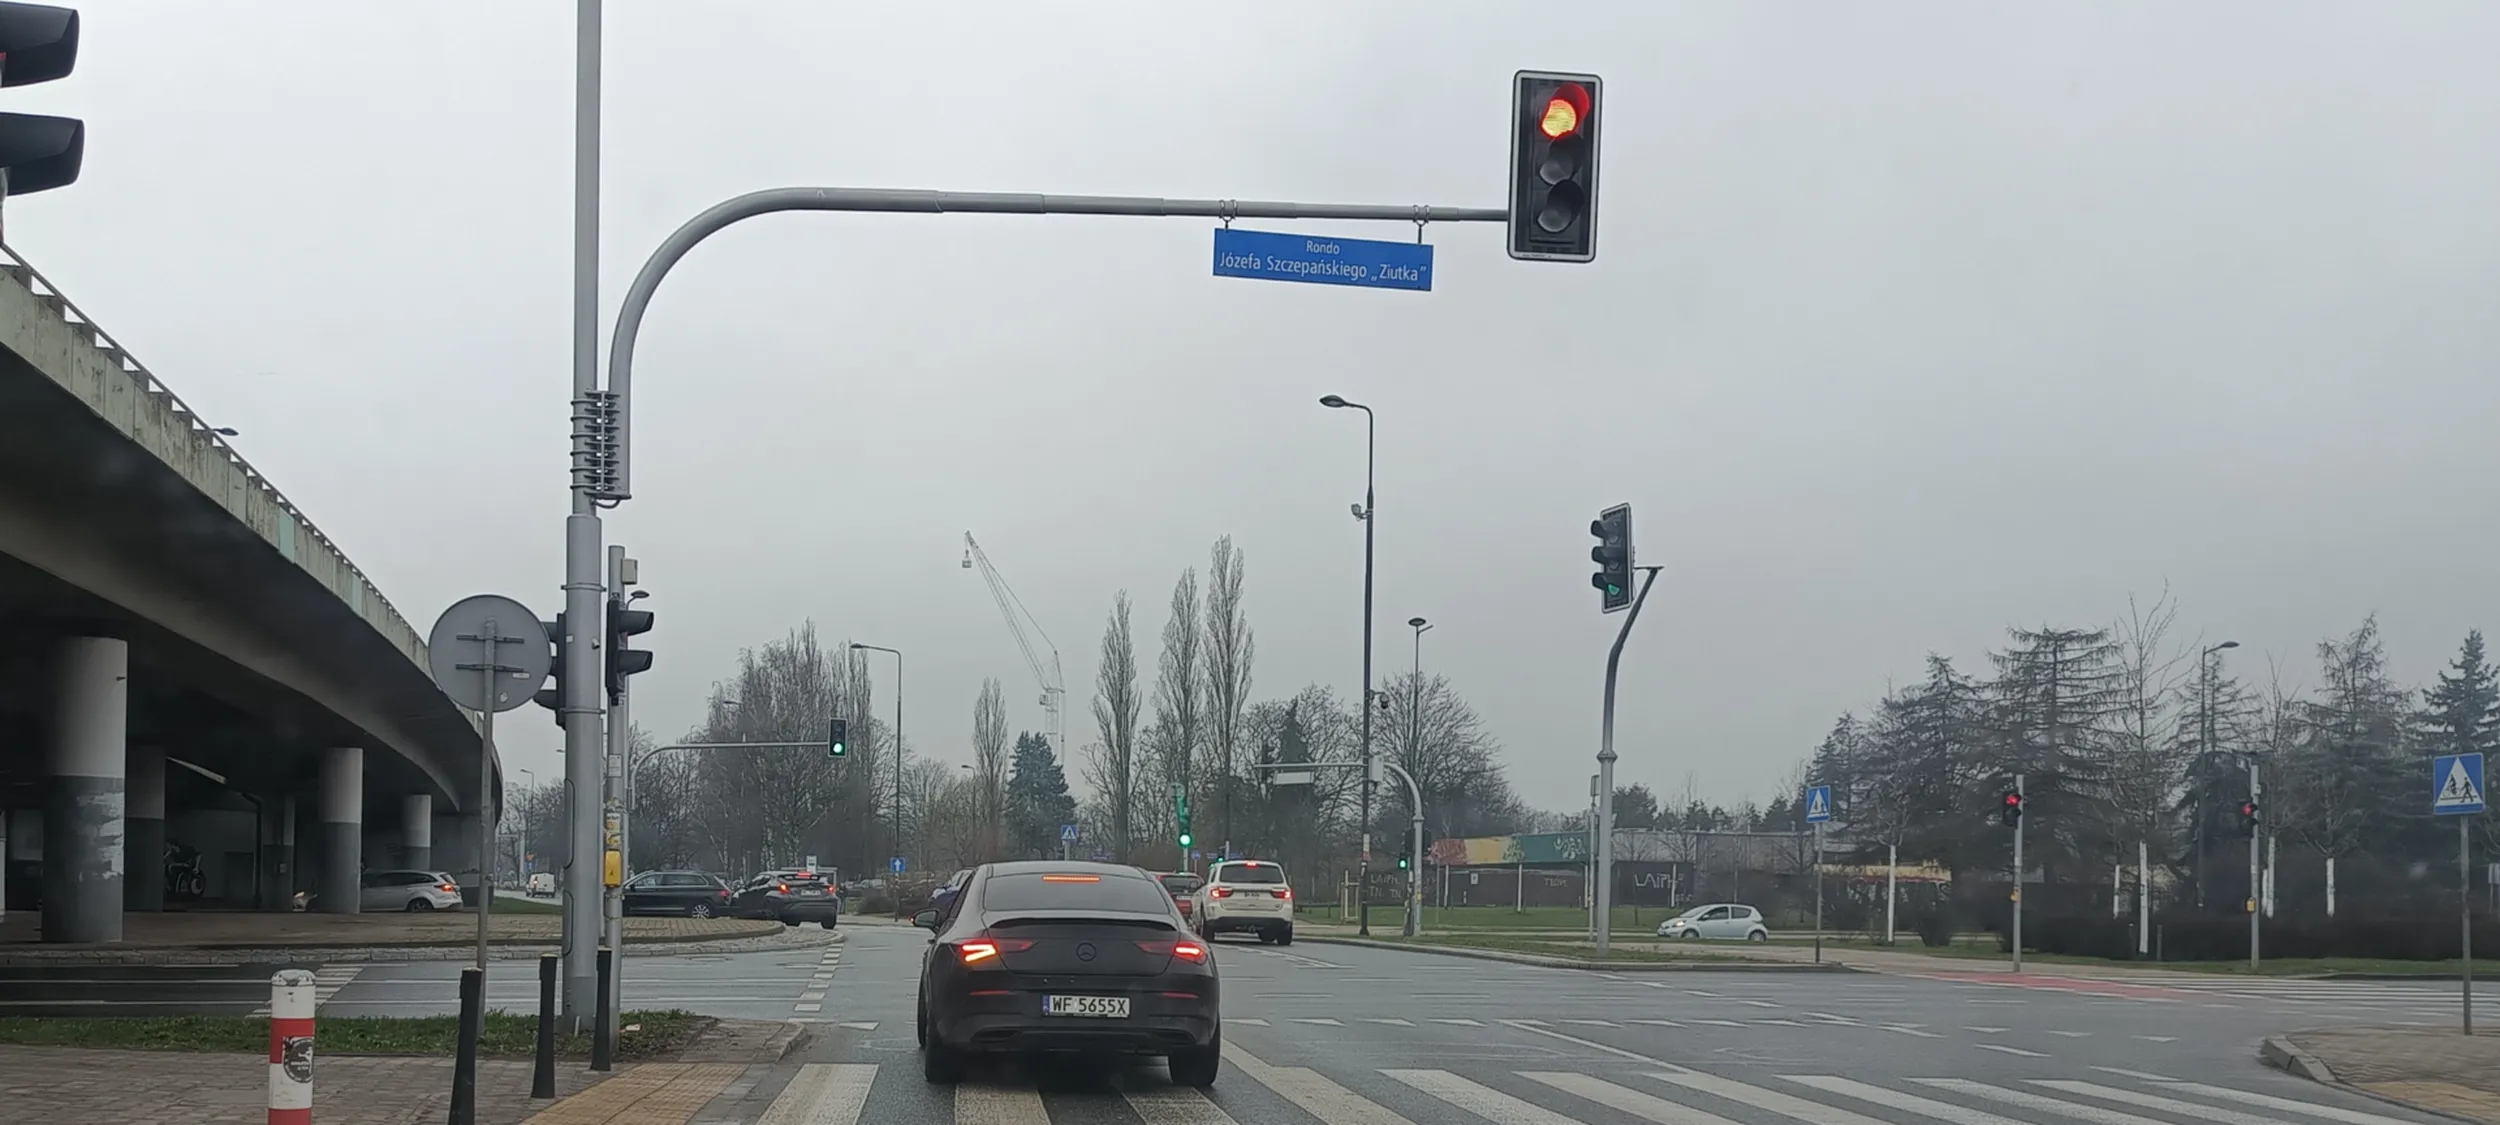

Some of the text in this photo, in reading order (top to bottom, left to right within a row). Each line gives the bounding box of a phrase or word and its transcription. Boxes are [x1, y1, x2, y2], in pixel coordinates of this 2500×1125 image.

[1306, 240, 1340, 255] Rondo
[1220, 252, 1261, 270] Józefa
[1267, 256, 1367, 281] Szczepańskiego
[1052, 997, 1072, 1011] WF
[1078, 998, 1126, 1014] 5655X
